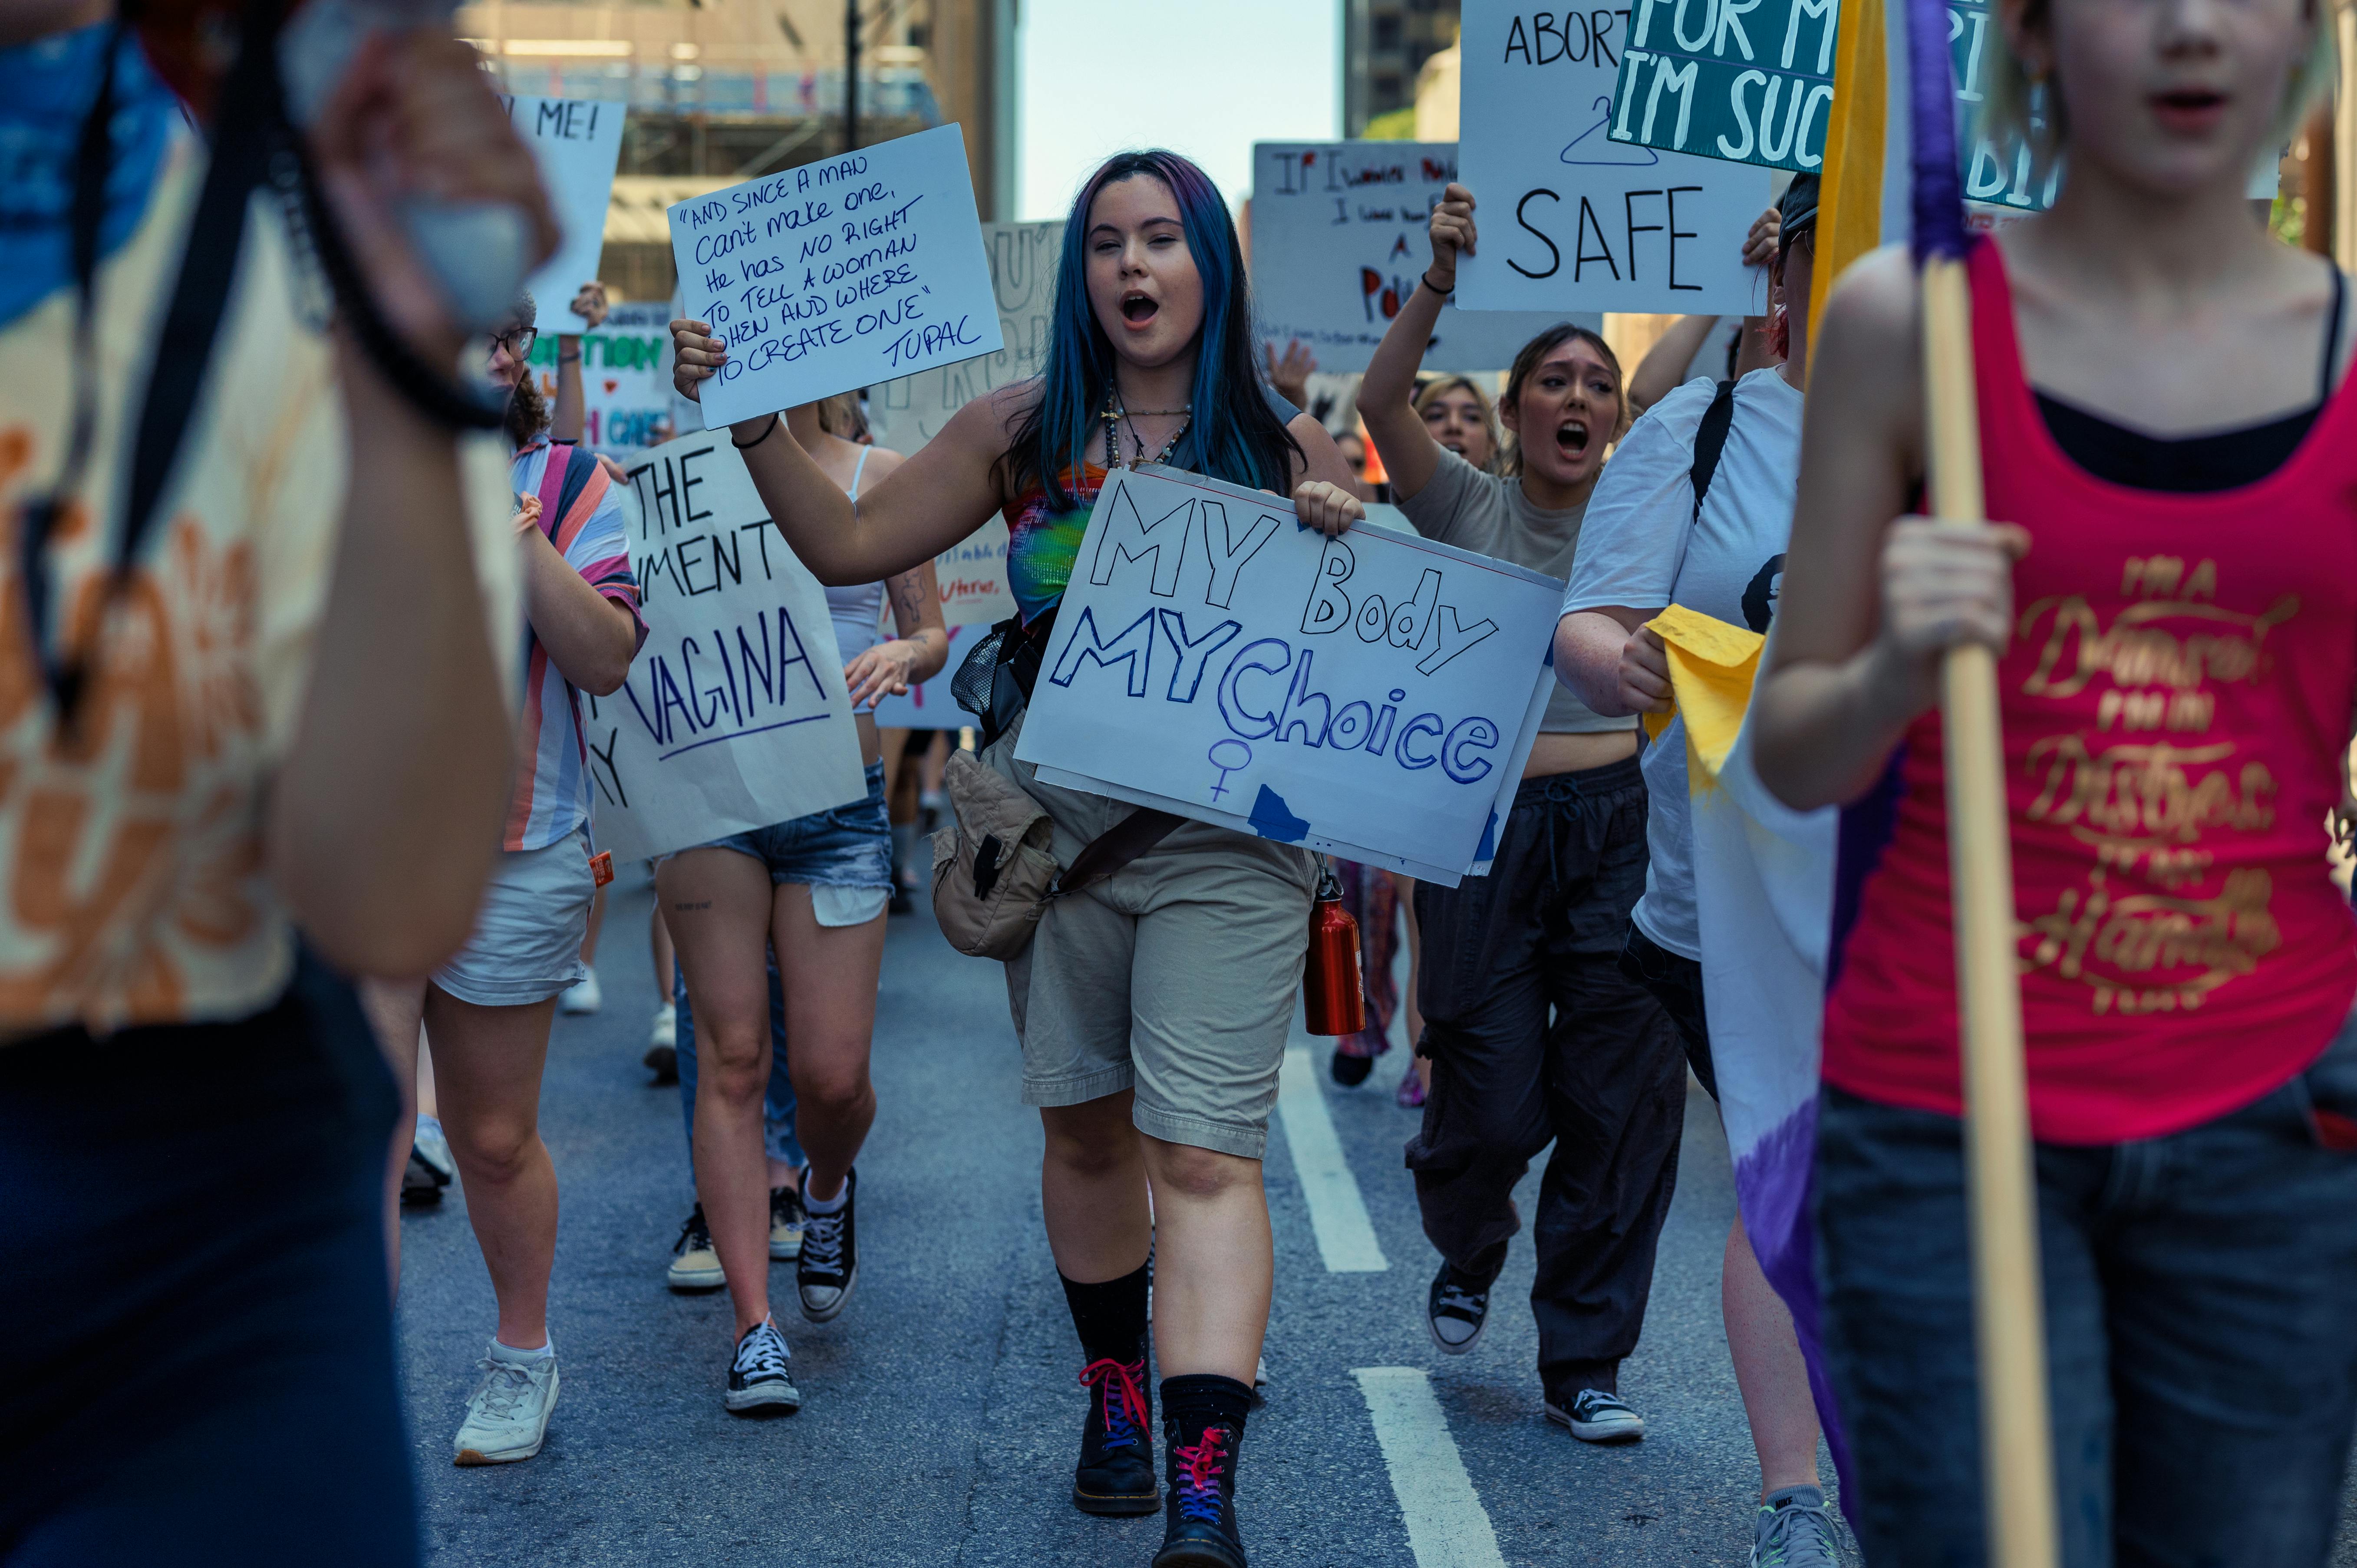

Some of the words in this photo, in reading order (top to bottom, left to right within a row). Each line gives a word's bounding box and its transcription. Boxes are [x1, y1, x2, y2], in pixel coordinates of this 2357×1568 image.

[536, 98, 600, 142] ME!
[1610, 49, 1699, 151] I'M
[732, 178, 789, 214] SINCE
[797, 168, 810, 194] A
[767, 201, 834, 237] make
[705, 268, 735, 293] He
[740, 256, 785, 282] has
[800, 234, 832, 264] NO
[842, 194, 924, 245] RIGHT
[1506, 186, 1703, 291] SAFE
[702, 300, 730, 329] TO
[740, 284, 794, 313] TELL
[803, 267, 816, 291] A
[781, 295, 827, 325] AND
[836, 263, 918, 307] WHERE
[748, 319, 853, 371] CREATE
[882, 315, 982, 367] TUPAC
[626, 445, 715, 541] THE
[636, 519, 774, 608] MENT
[1089, 479, 1281, 610] MY
[1299, 538, 1500, 677] Body
[624, 606, 827, 746] VAGINA
[1049, 606, 1243, 704] MY
[1217, 637, 1500, 785] Choice
